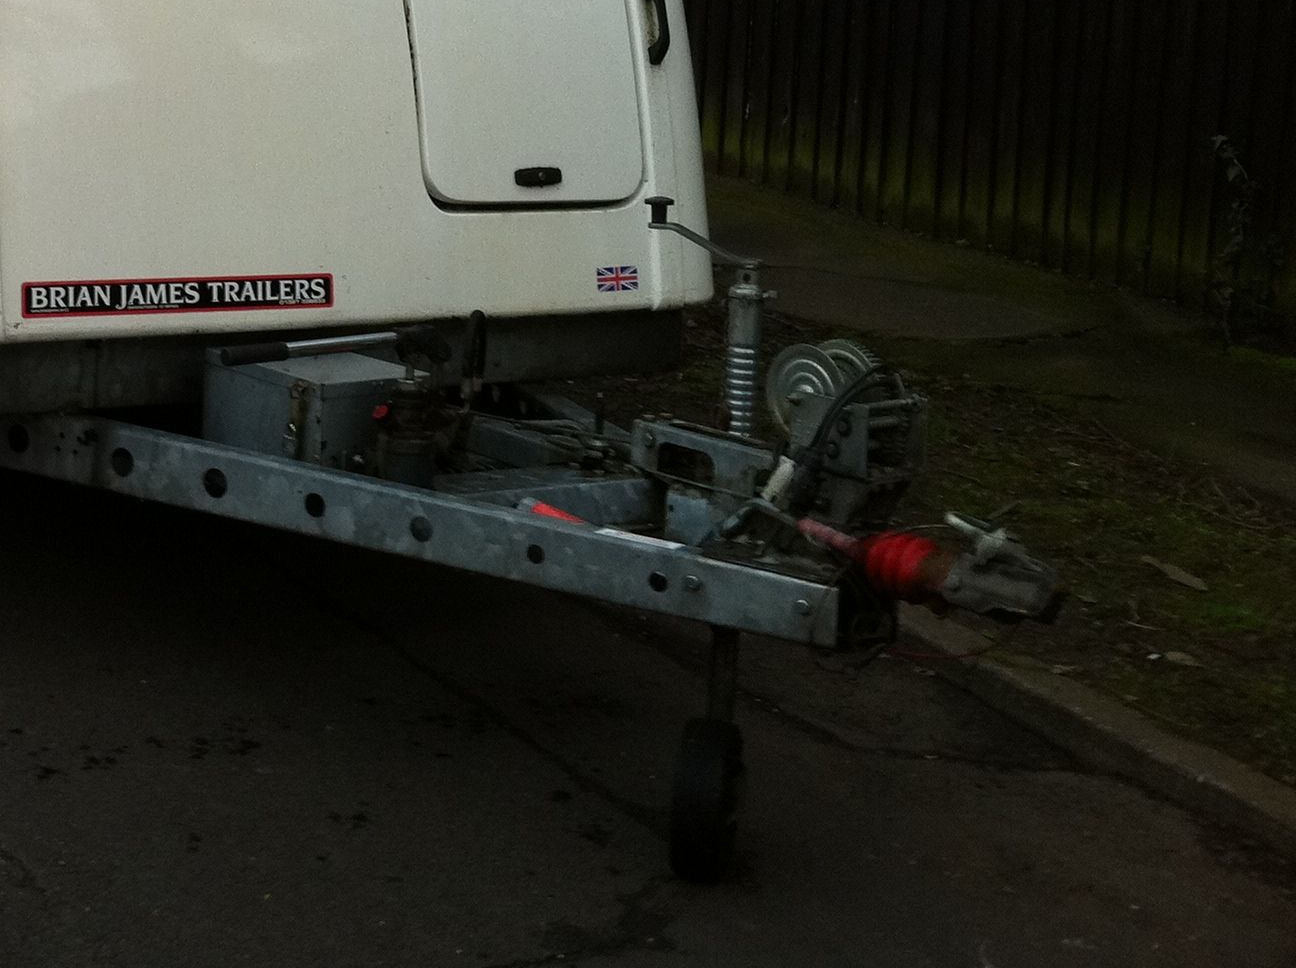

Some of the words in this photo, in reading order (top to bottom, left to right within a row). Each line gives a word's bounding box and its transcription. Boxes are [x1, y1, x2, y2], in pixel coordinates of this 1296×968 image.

[30, 284, 110, 308] BRIAN
[115, 282, 200, 310] JAMES
[207, 278, 326, 303] TRAILERS
